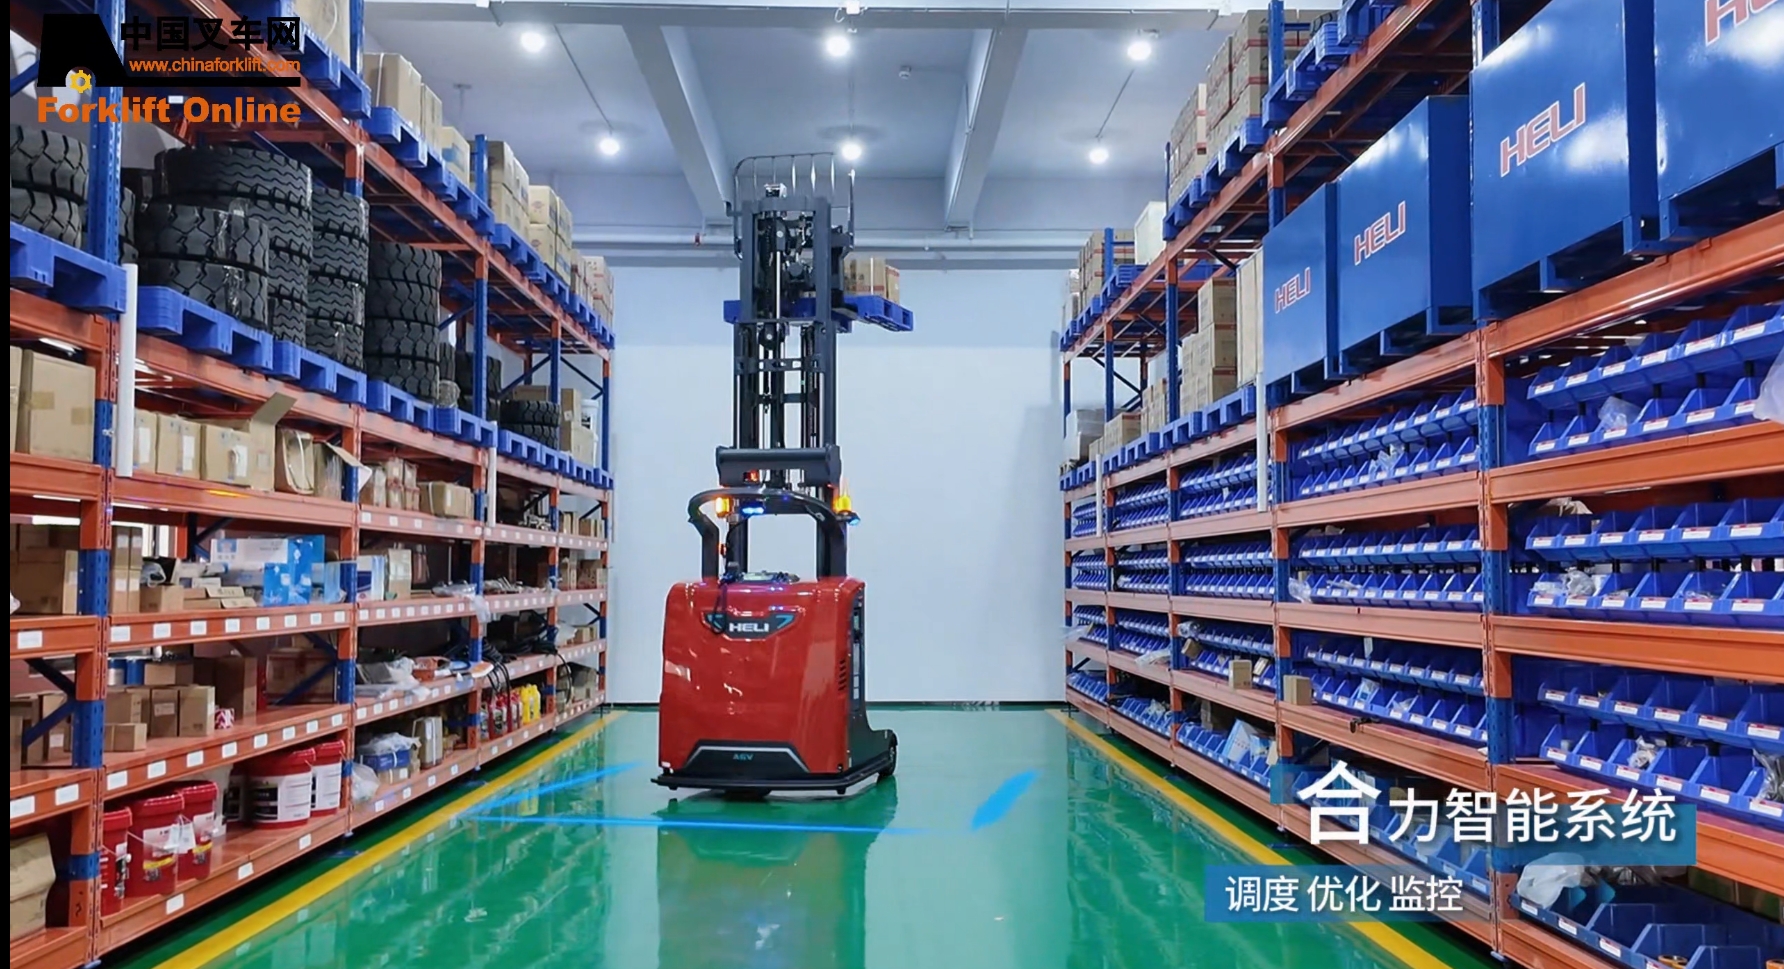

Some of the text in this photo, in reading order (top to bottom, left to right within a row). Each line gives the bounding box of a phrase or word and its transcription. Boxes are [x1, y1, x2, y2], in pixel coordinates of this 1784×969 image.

[1500, 81, 1586, 178] HELI
[1353, 200, 1406, 266] HELI
[1274, 266, 1311, 314] HELI
[728, 622, 770, 633] HELI
